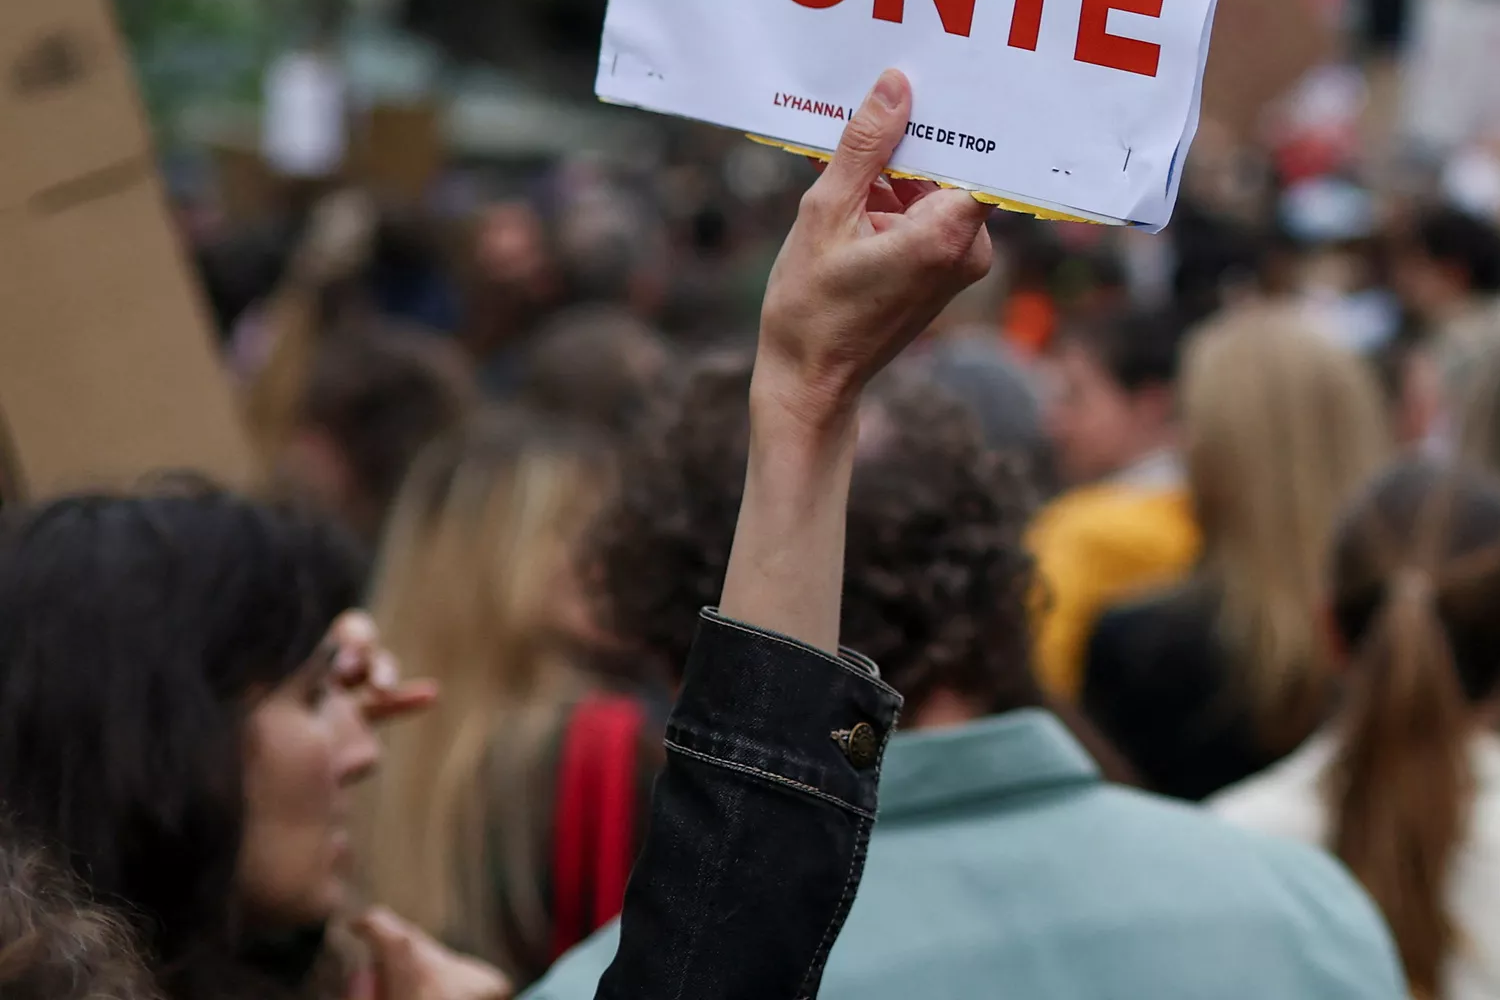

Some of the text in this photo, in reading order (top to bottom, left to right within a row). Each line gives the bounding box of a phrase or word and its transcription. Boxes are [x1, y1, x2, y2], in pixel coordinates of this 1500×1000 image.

[773, 92, 996, 154] LYHANNA DE TROP
